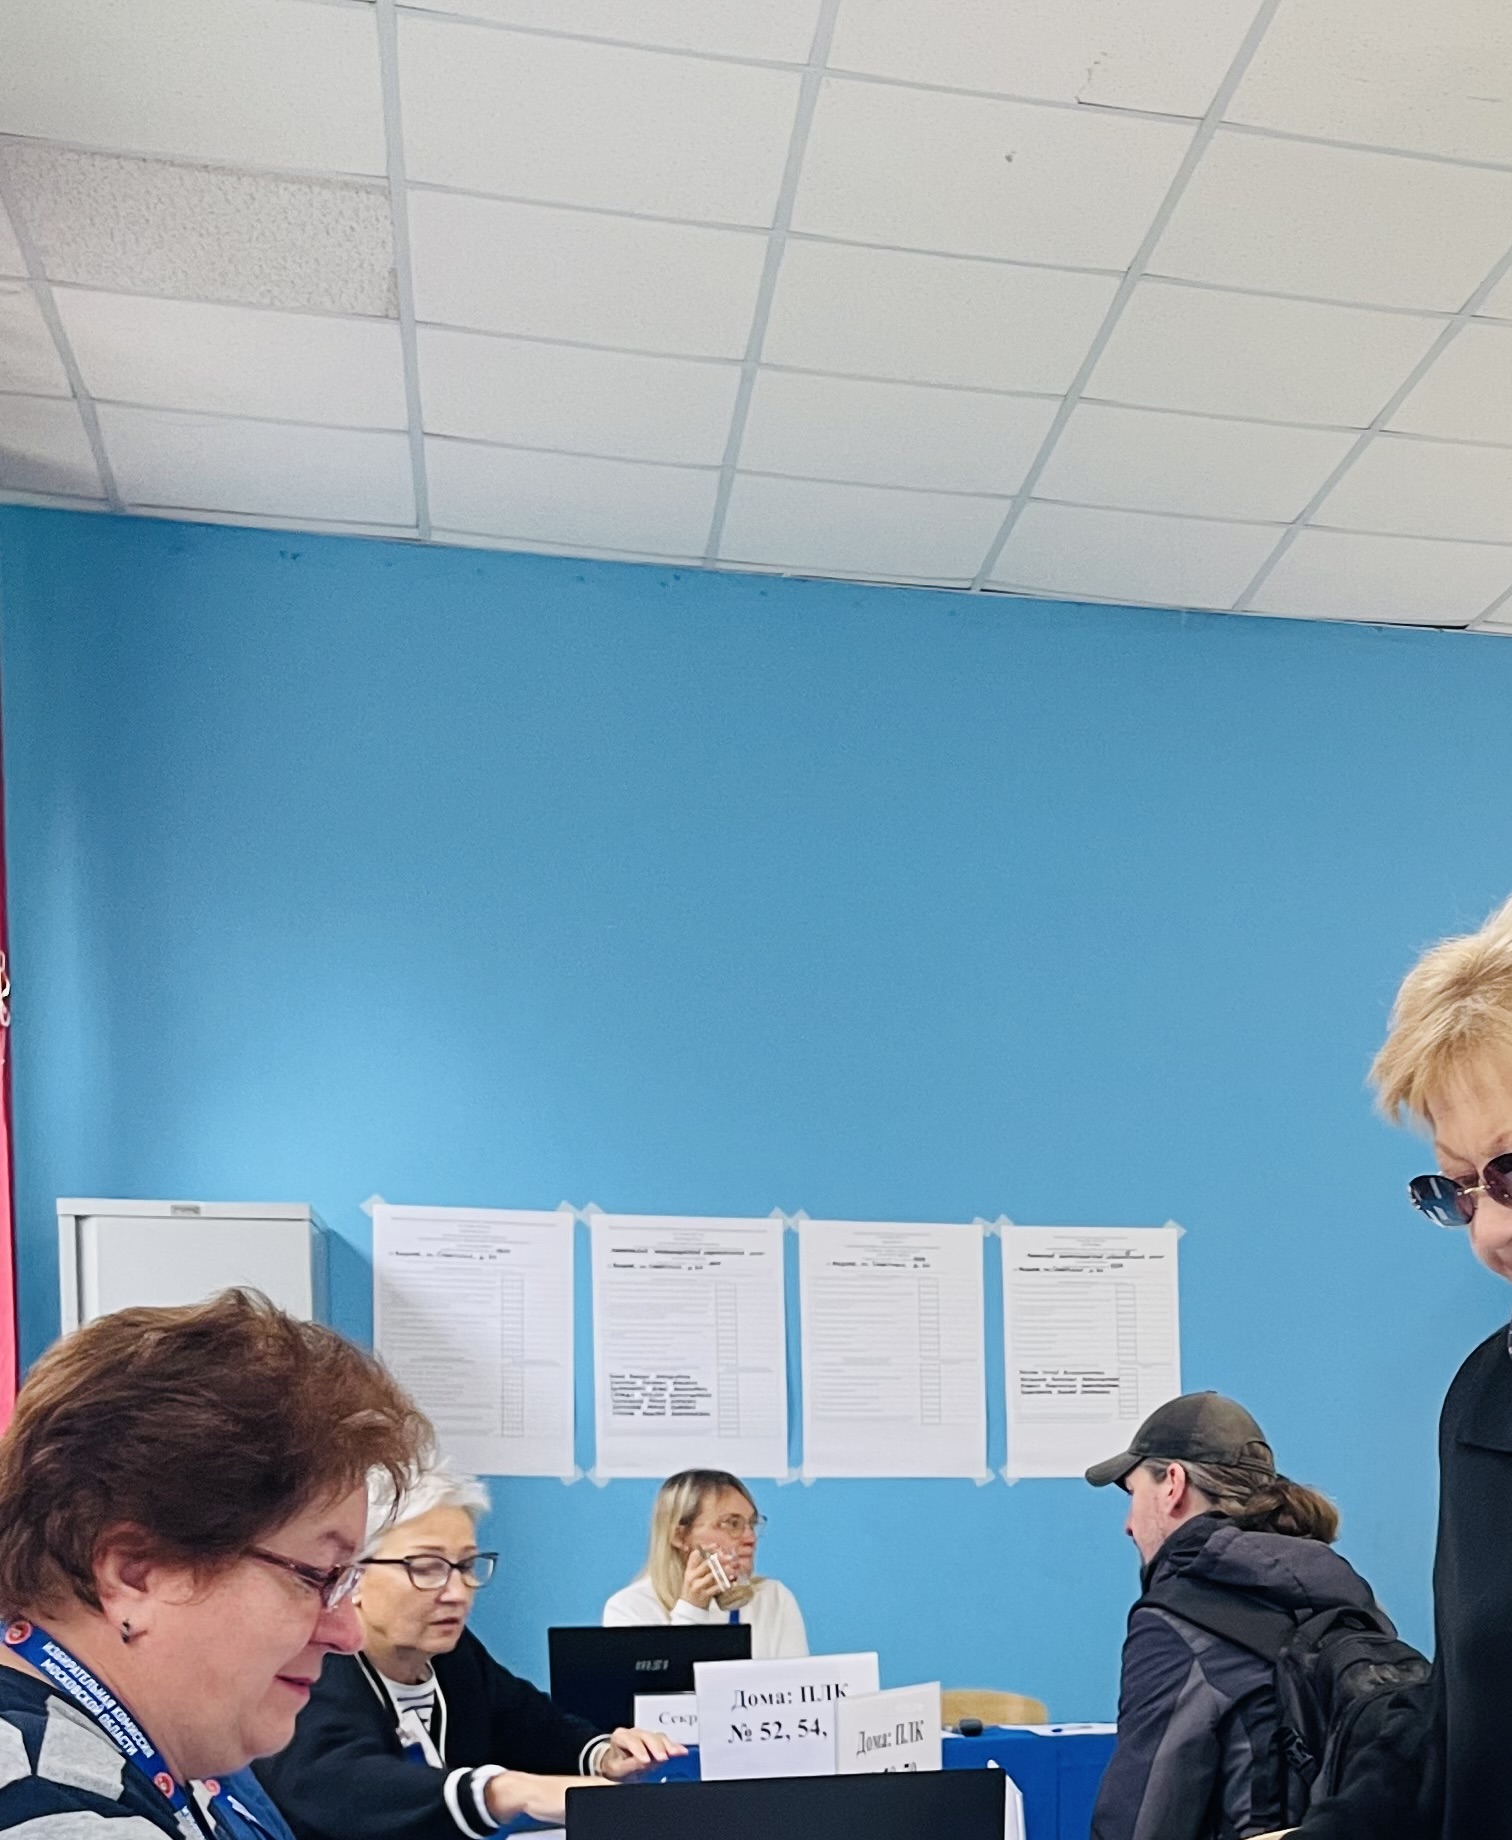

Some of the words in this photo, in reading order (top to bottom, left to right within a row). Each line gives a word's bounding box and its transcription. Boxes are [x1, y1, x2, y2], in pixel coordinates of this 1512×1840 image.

[40, 1658, 104, 1716] МОСКОВСКОЙ
[98, 1713, 139, 1757] ОБЛАСТИ
[731, 1690, 792, 1712] Дома:
[800, 1683, 848, 1703] ПЛК
[728, 1723, 752, 1744] №
[760, 1721, 791, 1742] 52,
[798, 1718, 827, 1739] 54,
